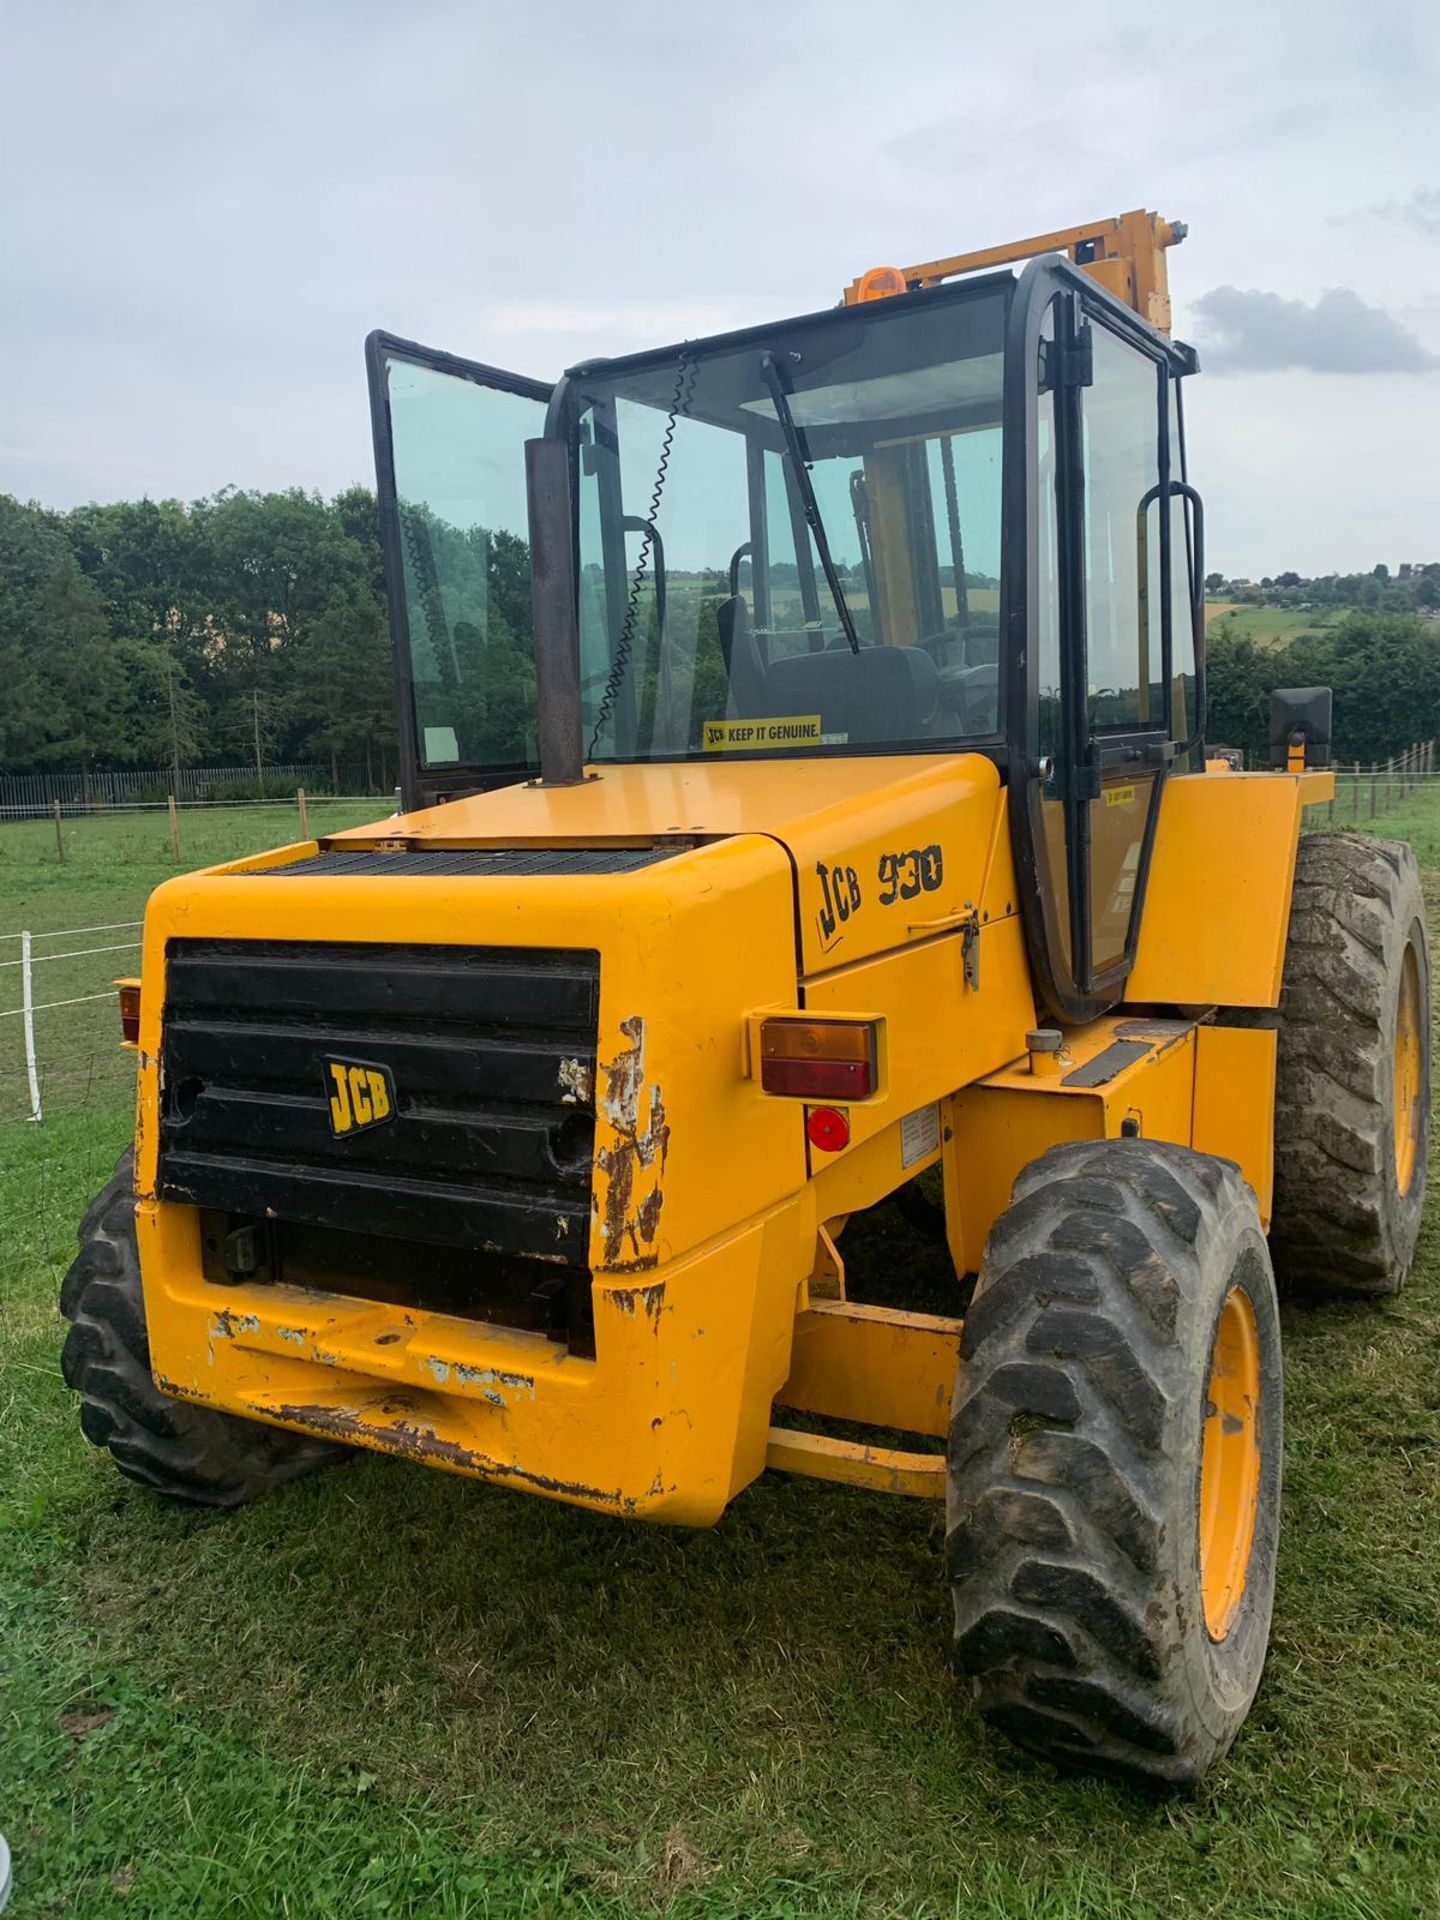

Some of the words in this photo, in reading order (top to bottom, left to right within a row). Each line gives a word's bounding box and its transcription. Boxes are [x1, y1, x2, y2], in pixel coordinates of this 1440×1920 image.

[708, 727, 725, 744] JCB
[728, 727, 754, 742] KEEP
[756, 726, 767, 741] IT
[768, 724, 819, 740] GENUINE.
[816, 861, 862, 940] JCB
[878, 844, 944, 906] 930
[330, 1063, 390, 1134] JCB
